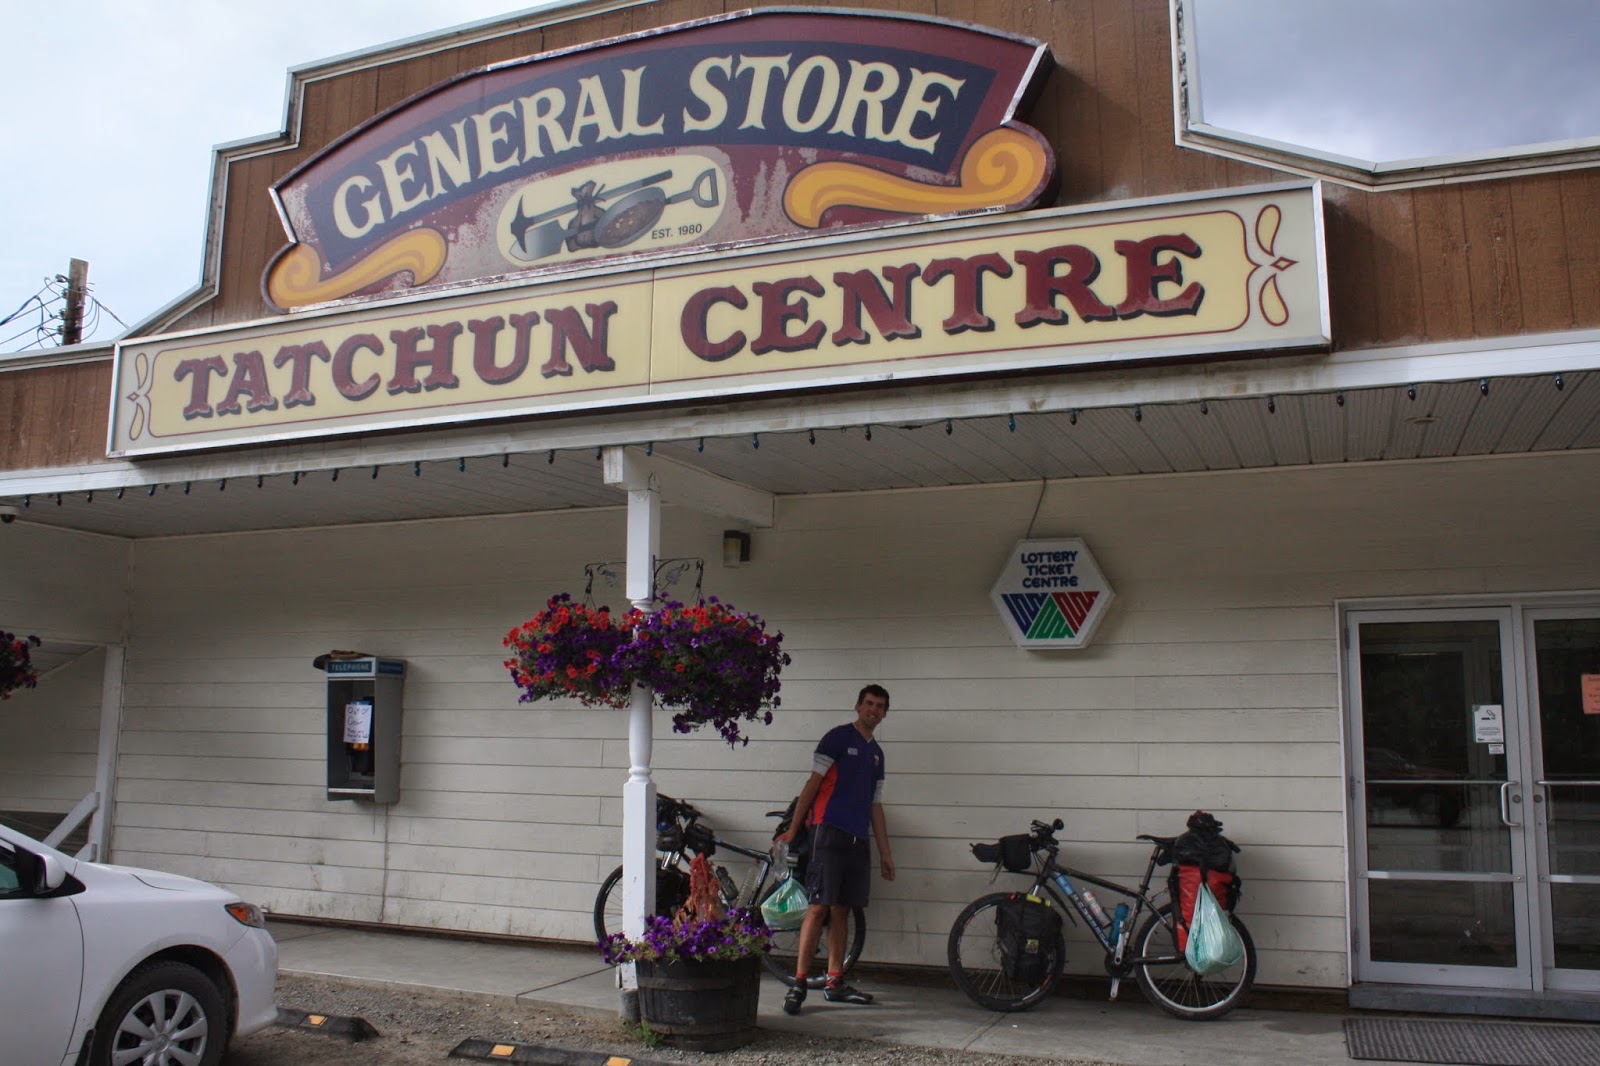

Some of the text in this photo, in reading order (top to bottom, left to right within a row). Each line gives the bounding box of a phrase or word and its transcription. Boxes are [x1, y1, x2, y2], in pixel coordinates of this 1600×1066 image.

[333, 53, 966, 239] GENERAL STORE
[651, 223, 703, 239] EST. 1980
[174, 231, 1205, 418] TATCHUN CENTRE
[1021, 550, 1078, 564] LOTTERY
[1026, 564, 1074, 576] TICKET
[1022, 576, 1078, 588] CENTRE
[331, 663, 370, 671] TELEPHONE
